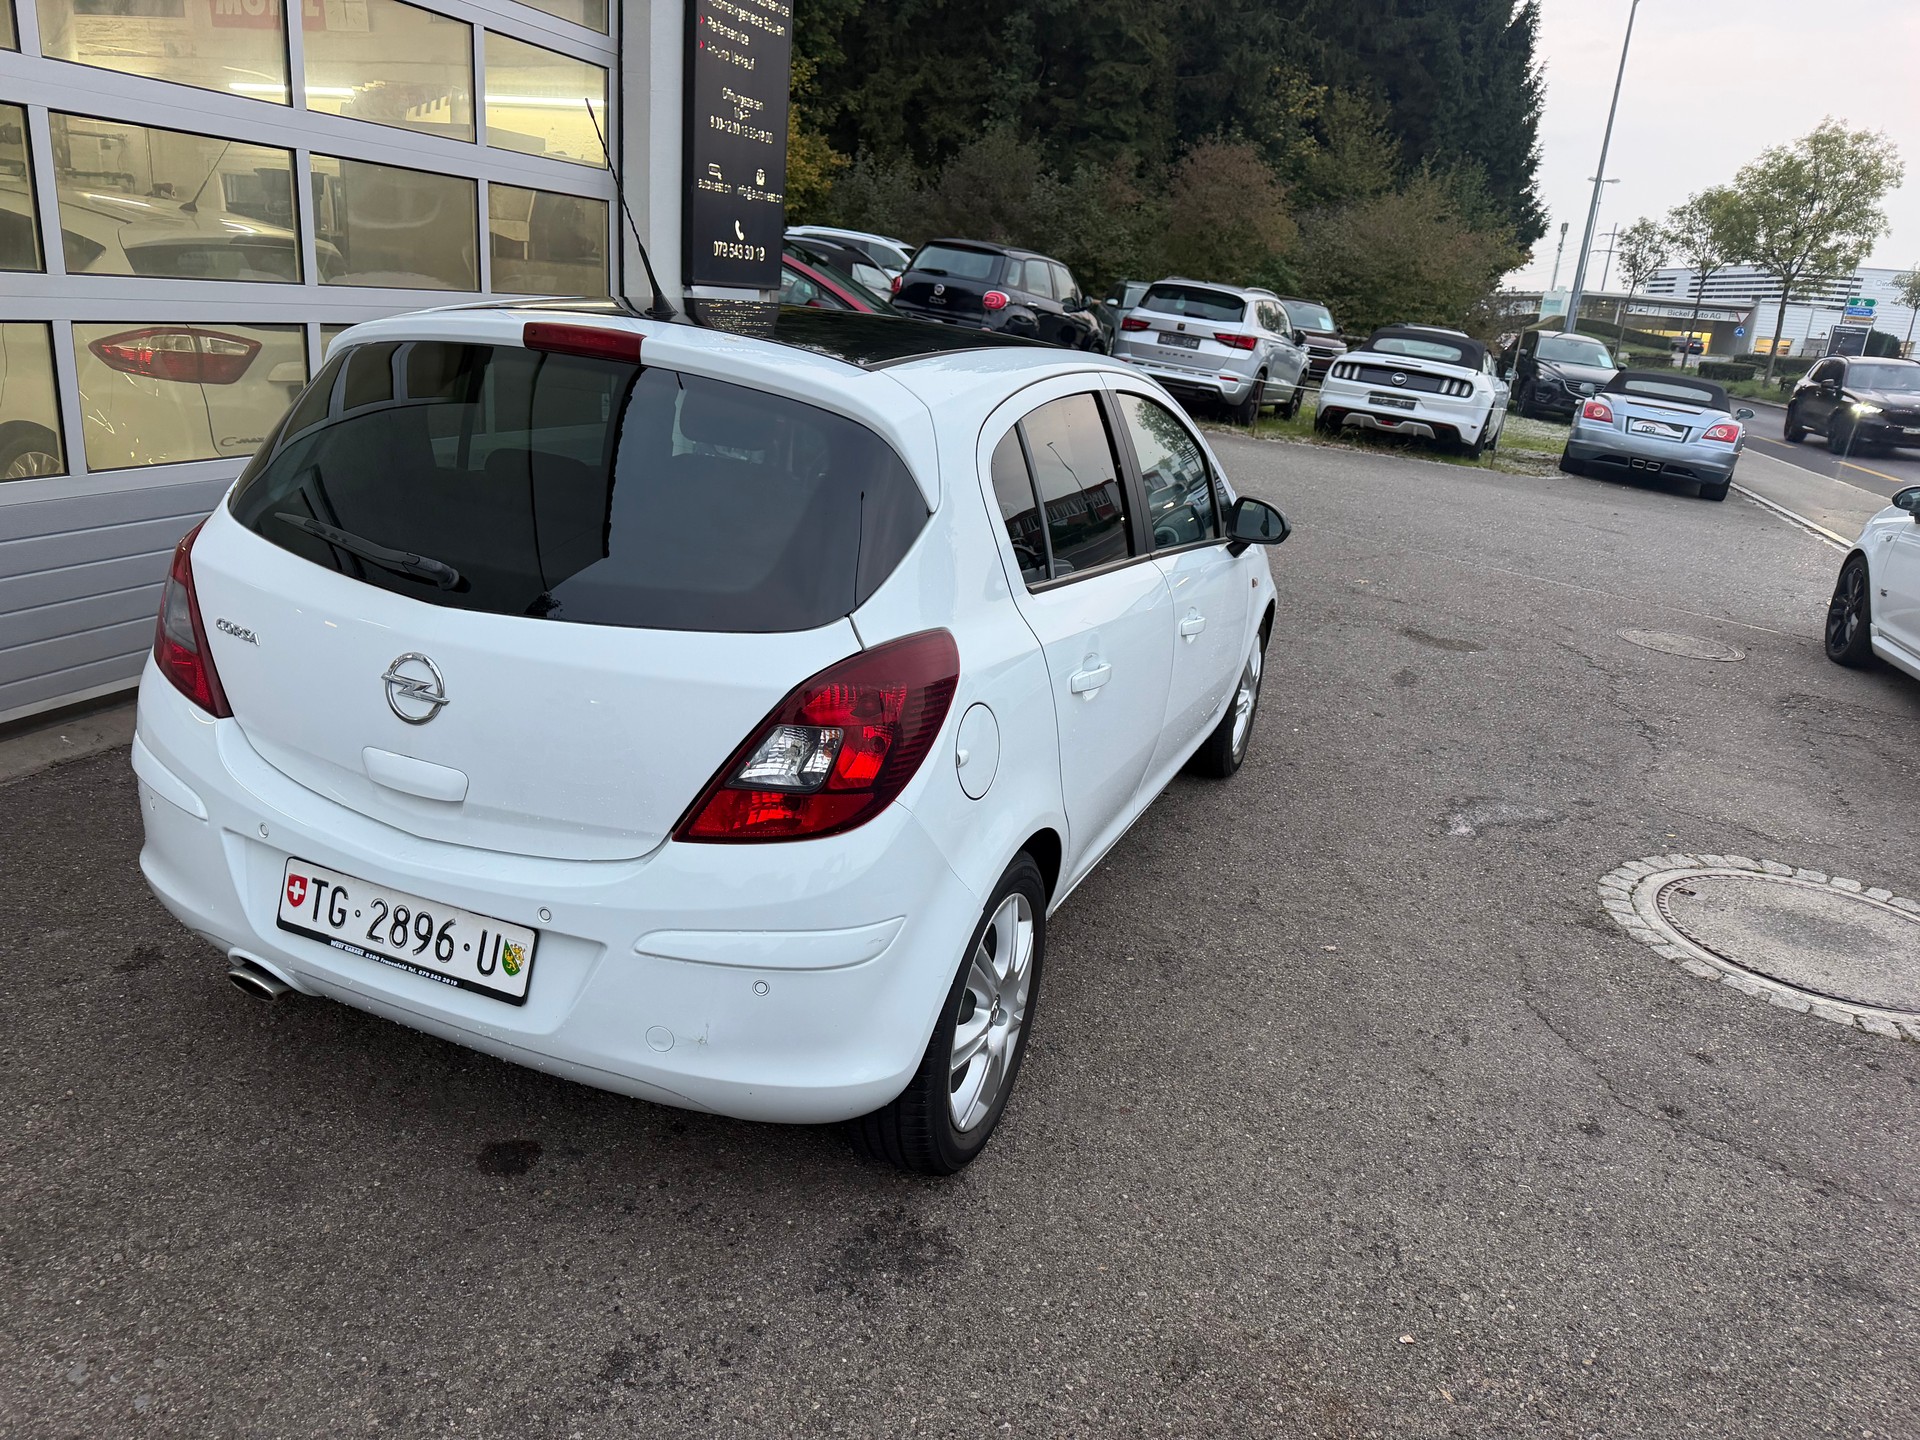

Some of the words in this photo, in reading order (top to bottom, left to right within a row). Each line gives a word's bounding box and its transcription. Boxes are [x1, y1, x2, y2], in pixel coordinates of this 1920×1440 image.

[713, 240, 728, 258] 079
[729, 242, 743, 259] 543
[755, 246, 766, 262] 19
[216, 618, 260, 646] CORSA
